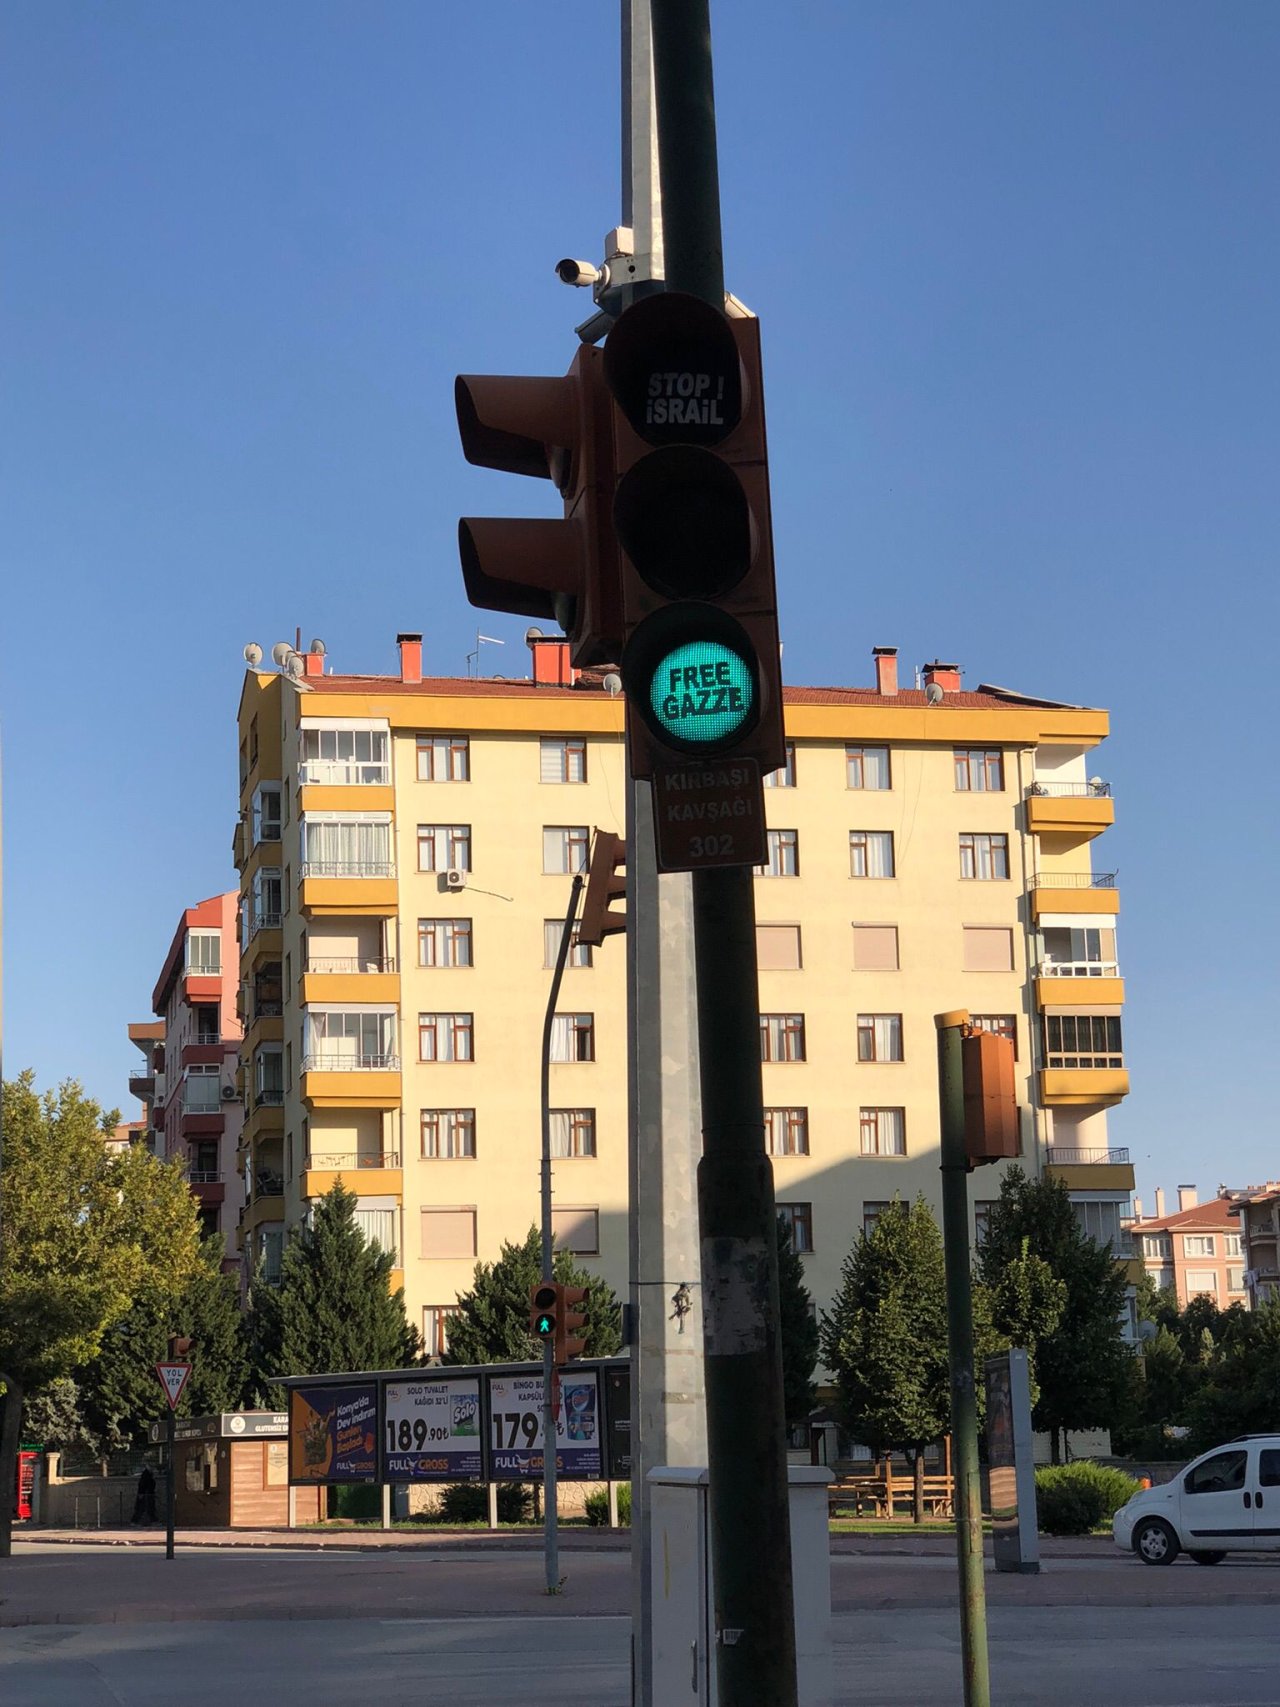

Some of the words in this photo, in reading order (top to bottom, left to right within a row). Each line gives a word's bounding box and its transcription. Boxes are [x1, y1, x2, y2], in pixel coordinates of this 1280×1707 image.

[647, 372, 711, 397] STOP
[717, 375, 725, 400] !
[669, 661, 731, 693] FREE
[662, 686, 745, 721] GAZZE
[664, 767, 750, 791] KIRBAŞI
[666, 795, 753, 824] KAVŞAĞI
[688, 833, 735, 858] 302
[166, 1369, 182, 1377] YOL
[167, 1378, 181, 1386] VER
[407, 1387, 423, 1396] SOLO
[424, 1386, 449, 1394] TUVALET
[415, 1396, 434, 1406] KAĞIDI
[337, 1418, 352, 1430] Dev
[336, 1462, 350, 1470] FULL
[388, 1459, 408, 1471] FULL
[418, 1458, 449, 1470] GROSS
[495, 1456, 518, 1469] FULL
[530, 1456, 564, 1468] GRS
